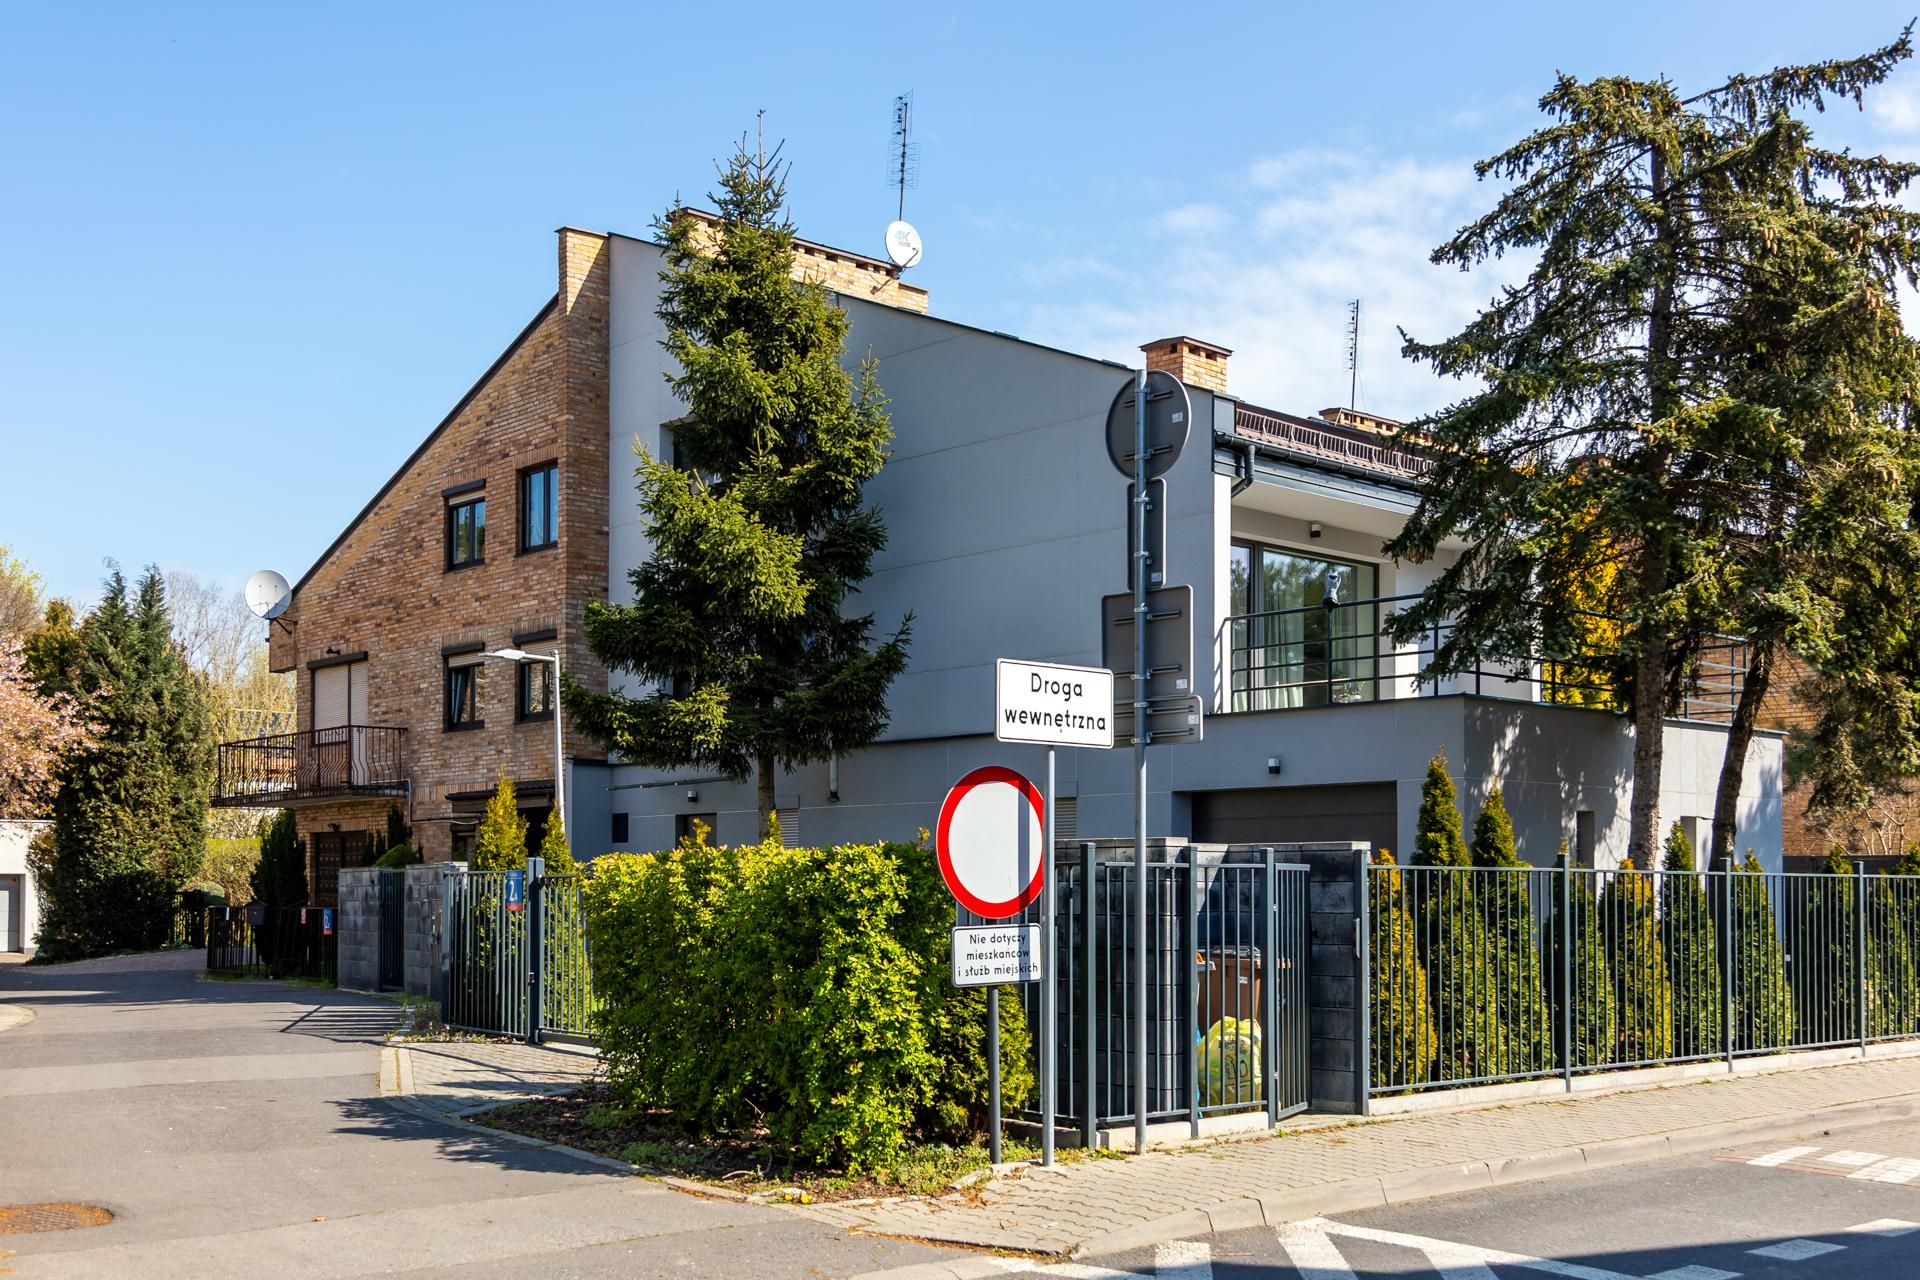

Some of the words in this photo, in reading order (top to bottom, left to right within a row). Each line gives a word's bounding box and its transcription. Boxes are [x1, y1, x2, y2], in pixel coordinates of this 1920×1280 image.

[1031, 672, 1083, 702] Droga
[1005, 708, 1106, 733] wewnętrzna
[969, 934, 986, 945] Nie
[990, 933, 1025, 945] dotyczy
[965, 964, 990, 977] służb
[994, 962, 1038, 976] miejskich
